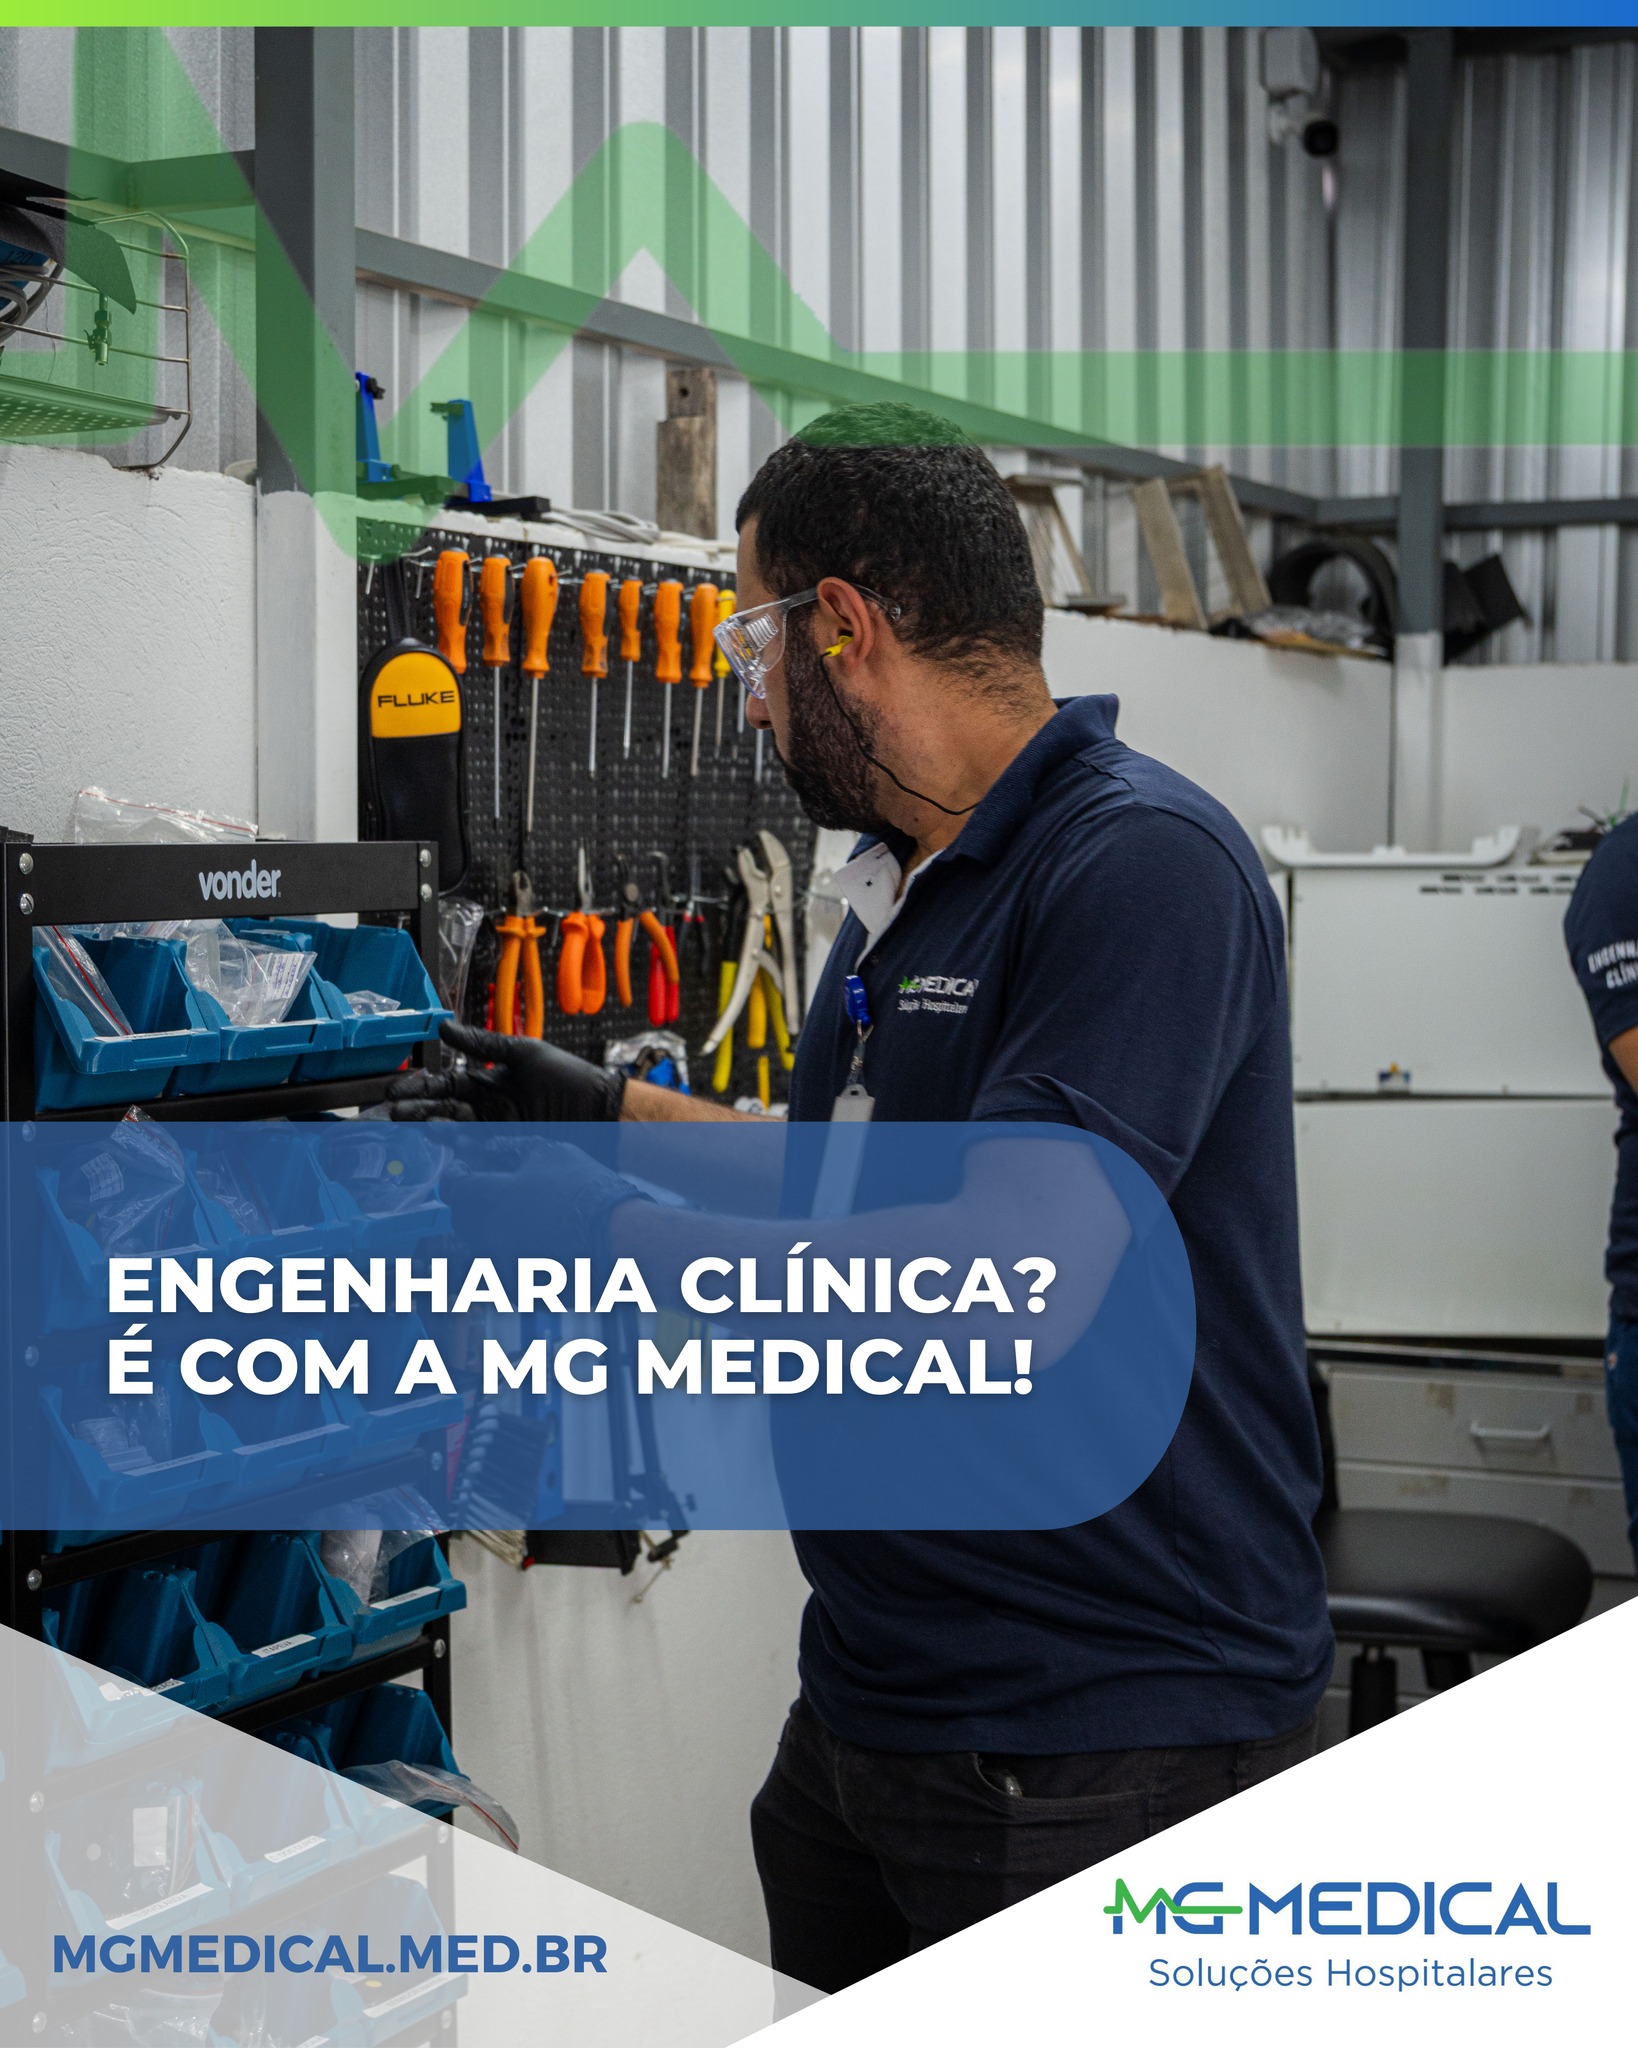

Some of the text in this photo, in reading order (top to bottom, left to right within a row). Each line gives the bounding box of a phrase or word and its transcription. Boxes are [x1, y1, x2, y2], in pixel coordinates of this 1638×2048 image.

[377, 690, 455, 708] FLUKE
[198, 858, 282, 901] vonder
[1587, 940, 1638, 974] ENGENH
